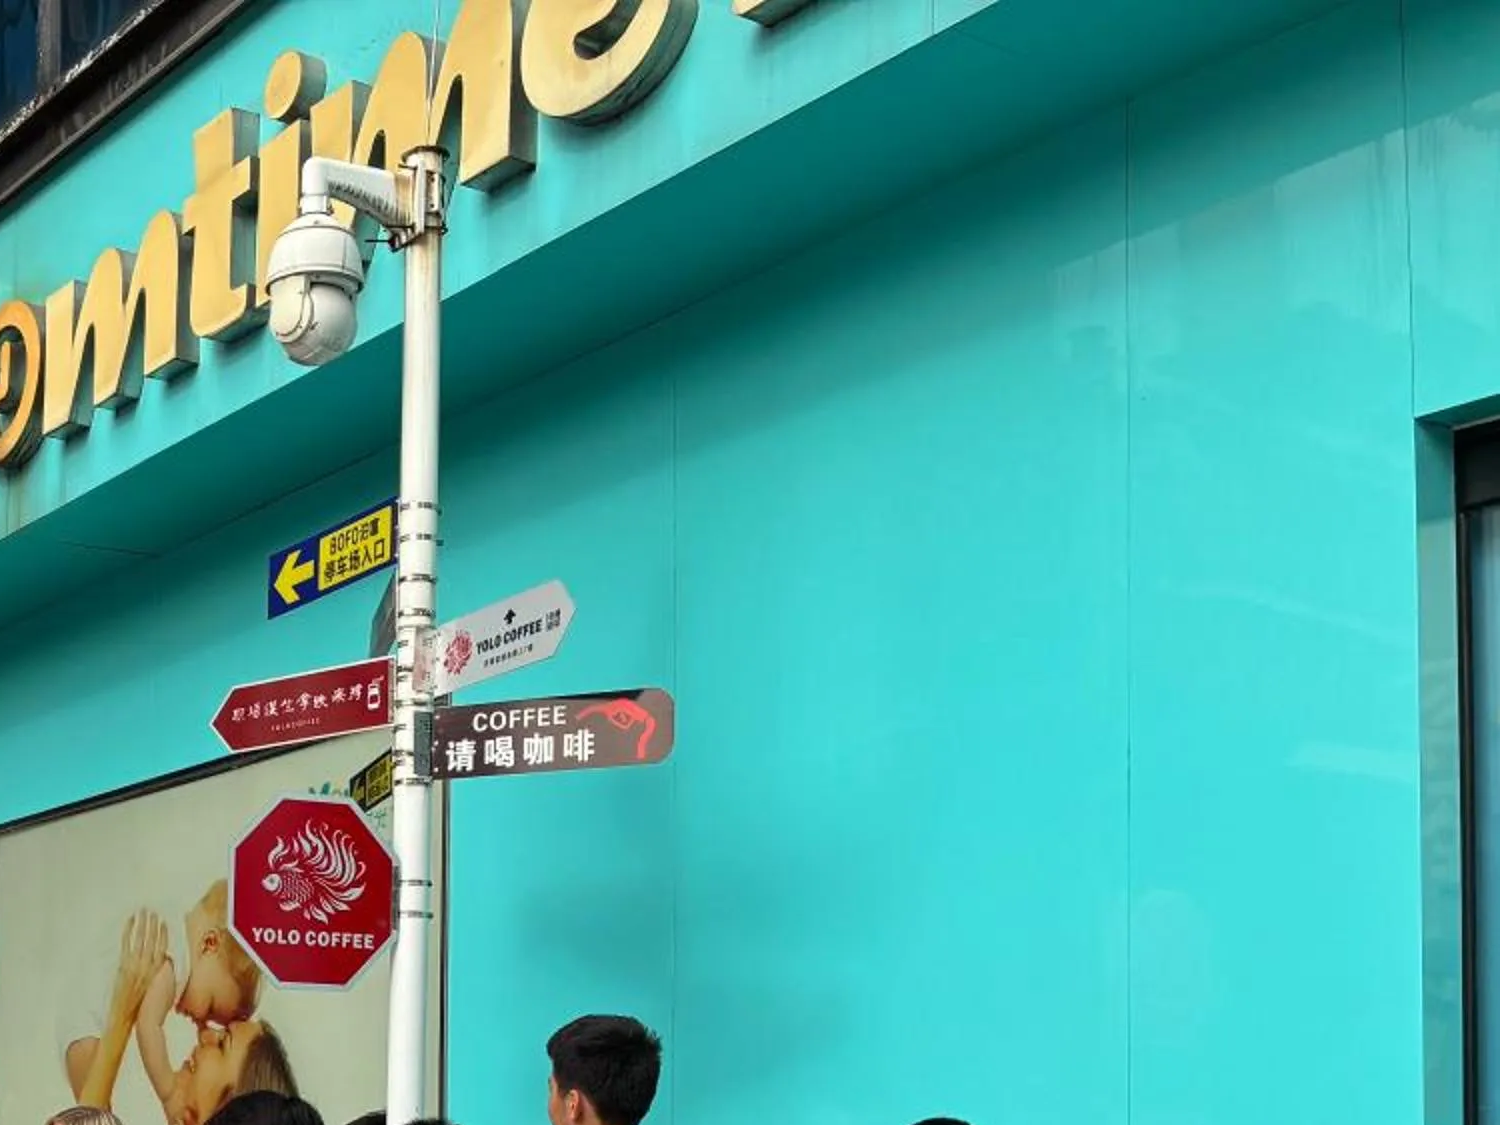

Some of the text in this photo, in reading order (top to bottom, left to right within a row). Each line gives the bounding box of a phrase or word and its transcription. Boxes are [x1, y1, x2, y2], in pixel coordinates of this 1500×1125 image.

[476, 633, 502, 656] YOLO
[503, 618, 542, 645] COFFEE
[472, 704, 568, 733] COFFEE
[445, 729, 595, 773] 请喝咖啡
[252, 927, 375, 950] YOLO COFFEE
